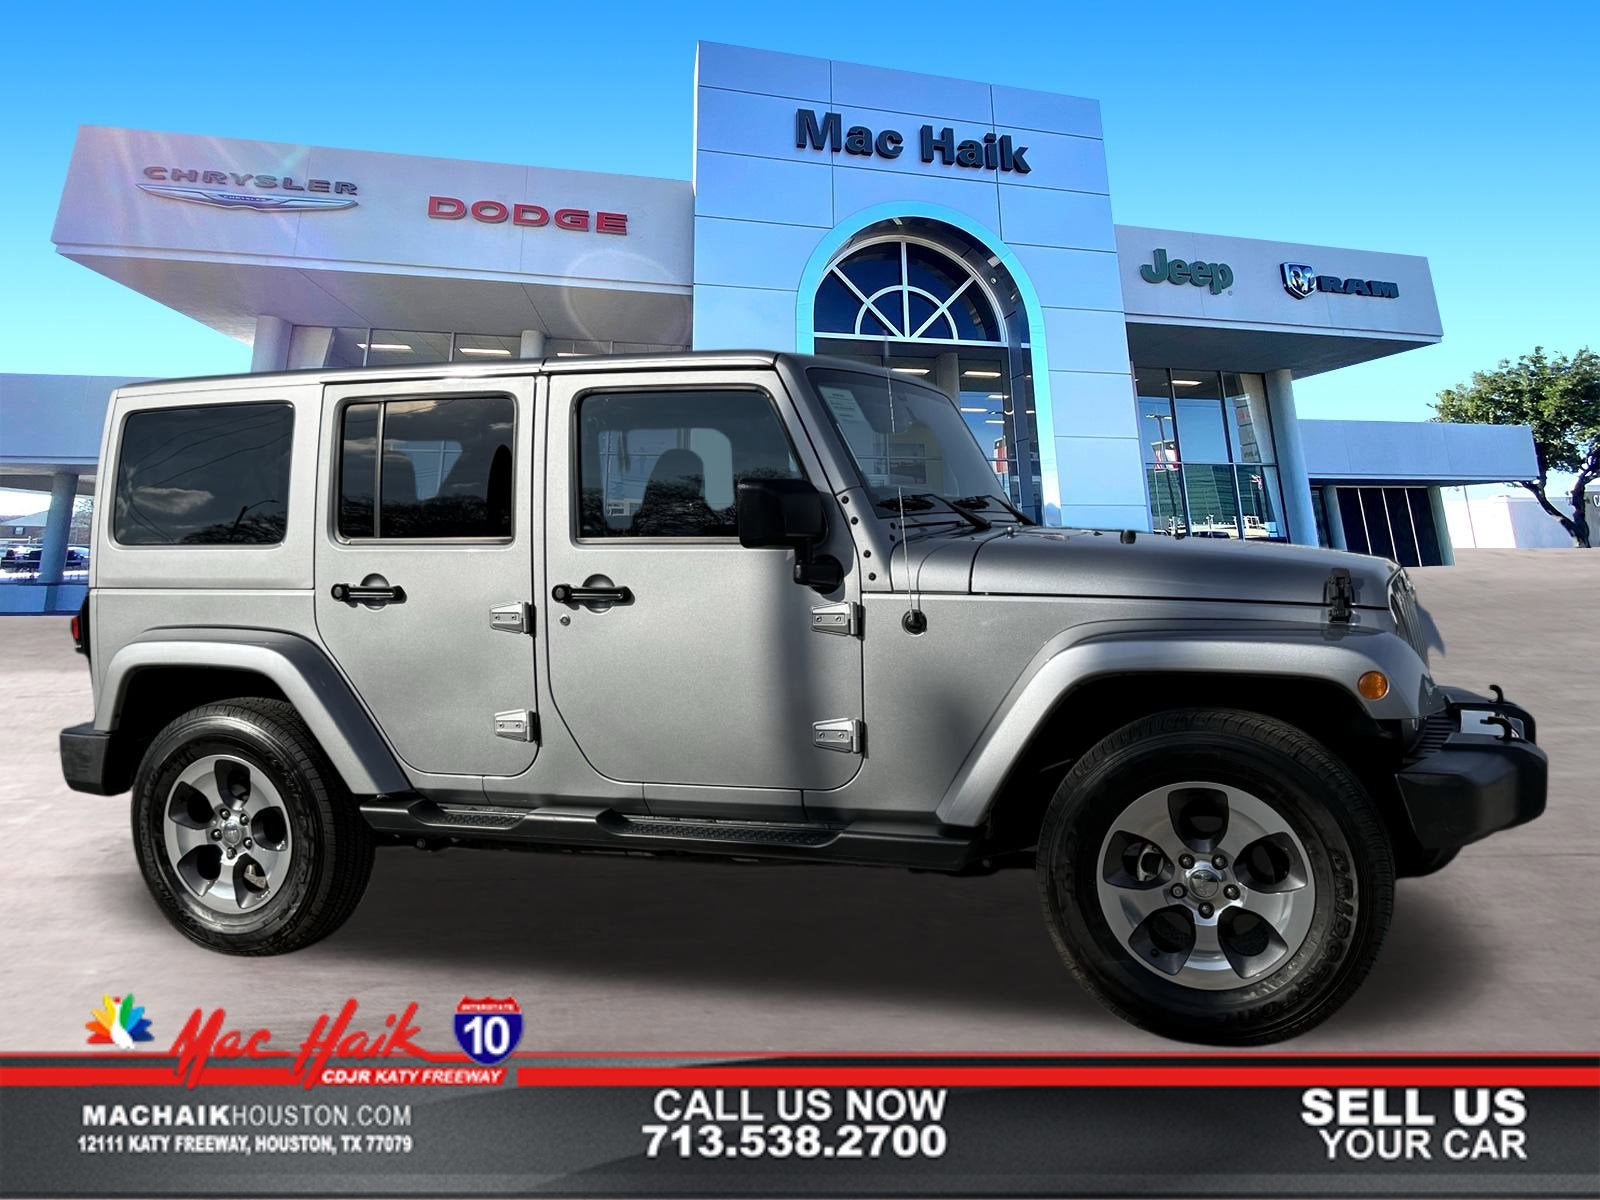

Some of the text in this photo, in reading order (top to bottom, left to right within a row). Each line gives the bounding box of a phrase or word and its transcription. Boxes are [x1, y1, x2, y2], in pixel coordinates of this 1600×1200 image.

[796, 108, 1032, 174] Mac Haik
[143, 165, 358, 196] CHRYSLER
[427, 195, 628, 237] DODGE
[1139, 248, 1234, 295] Jeep
[1316, 275, 1399, 299] RAM
